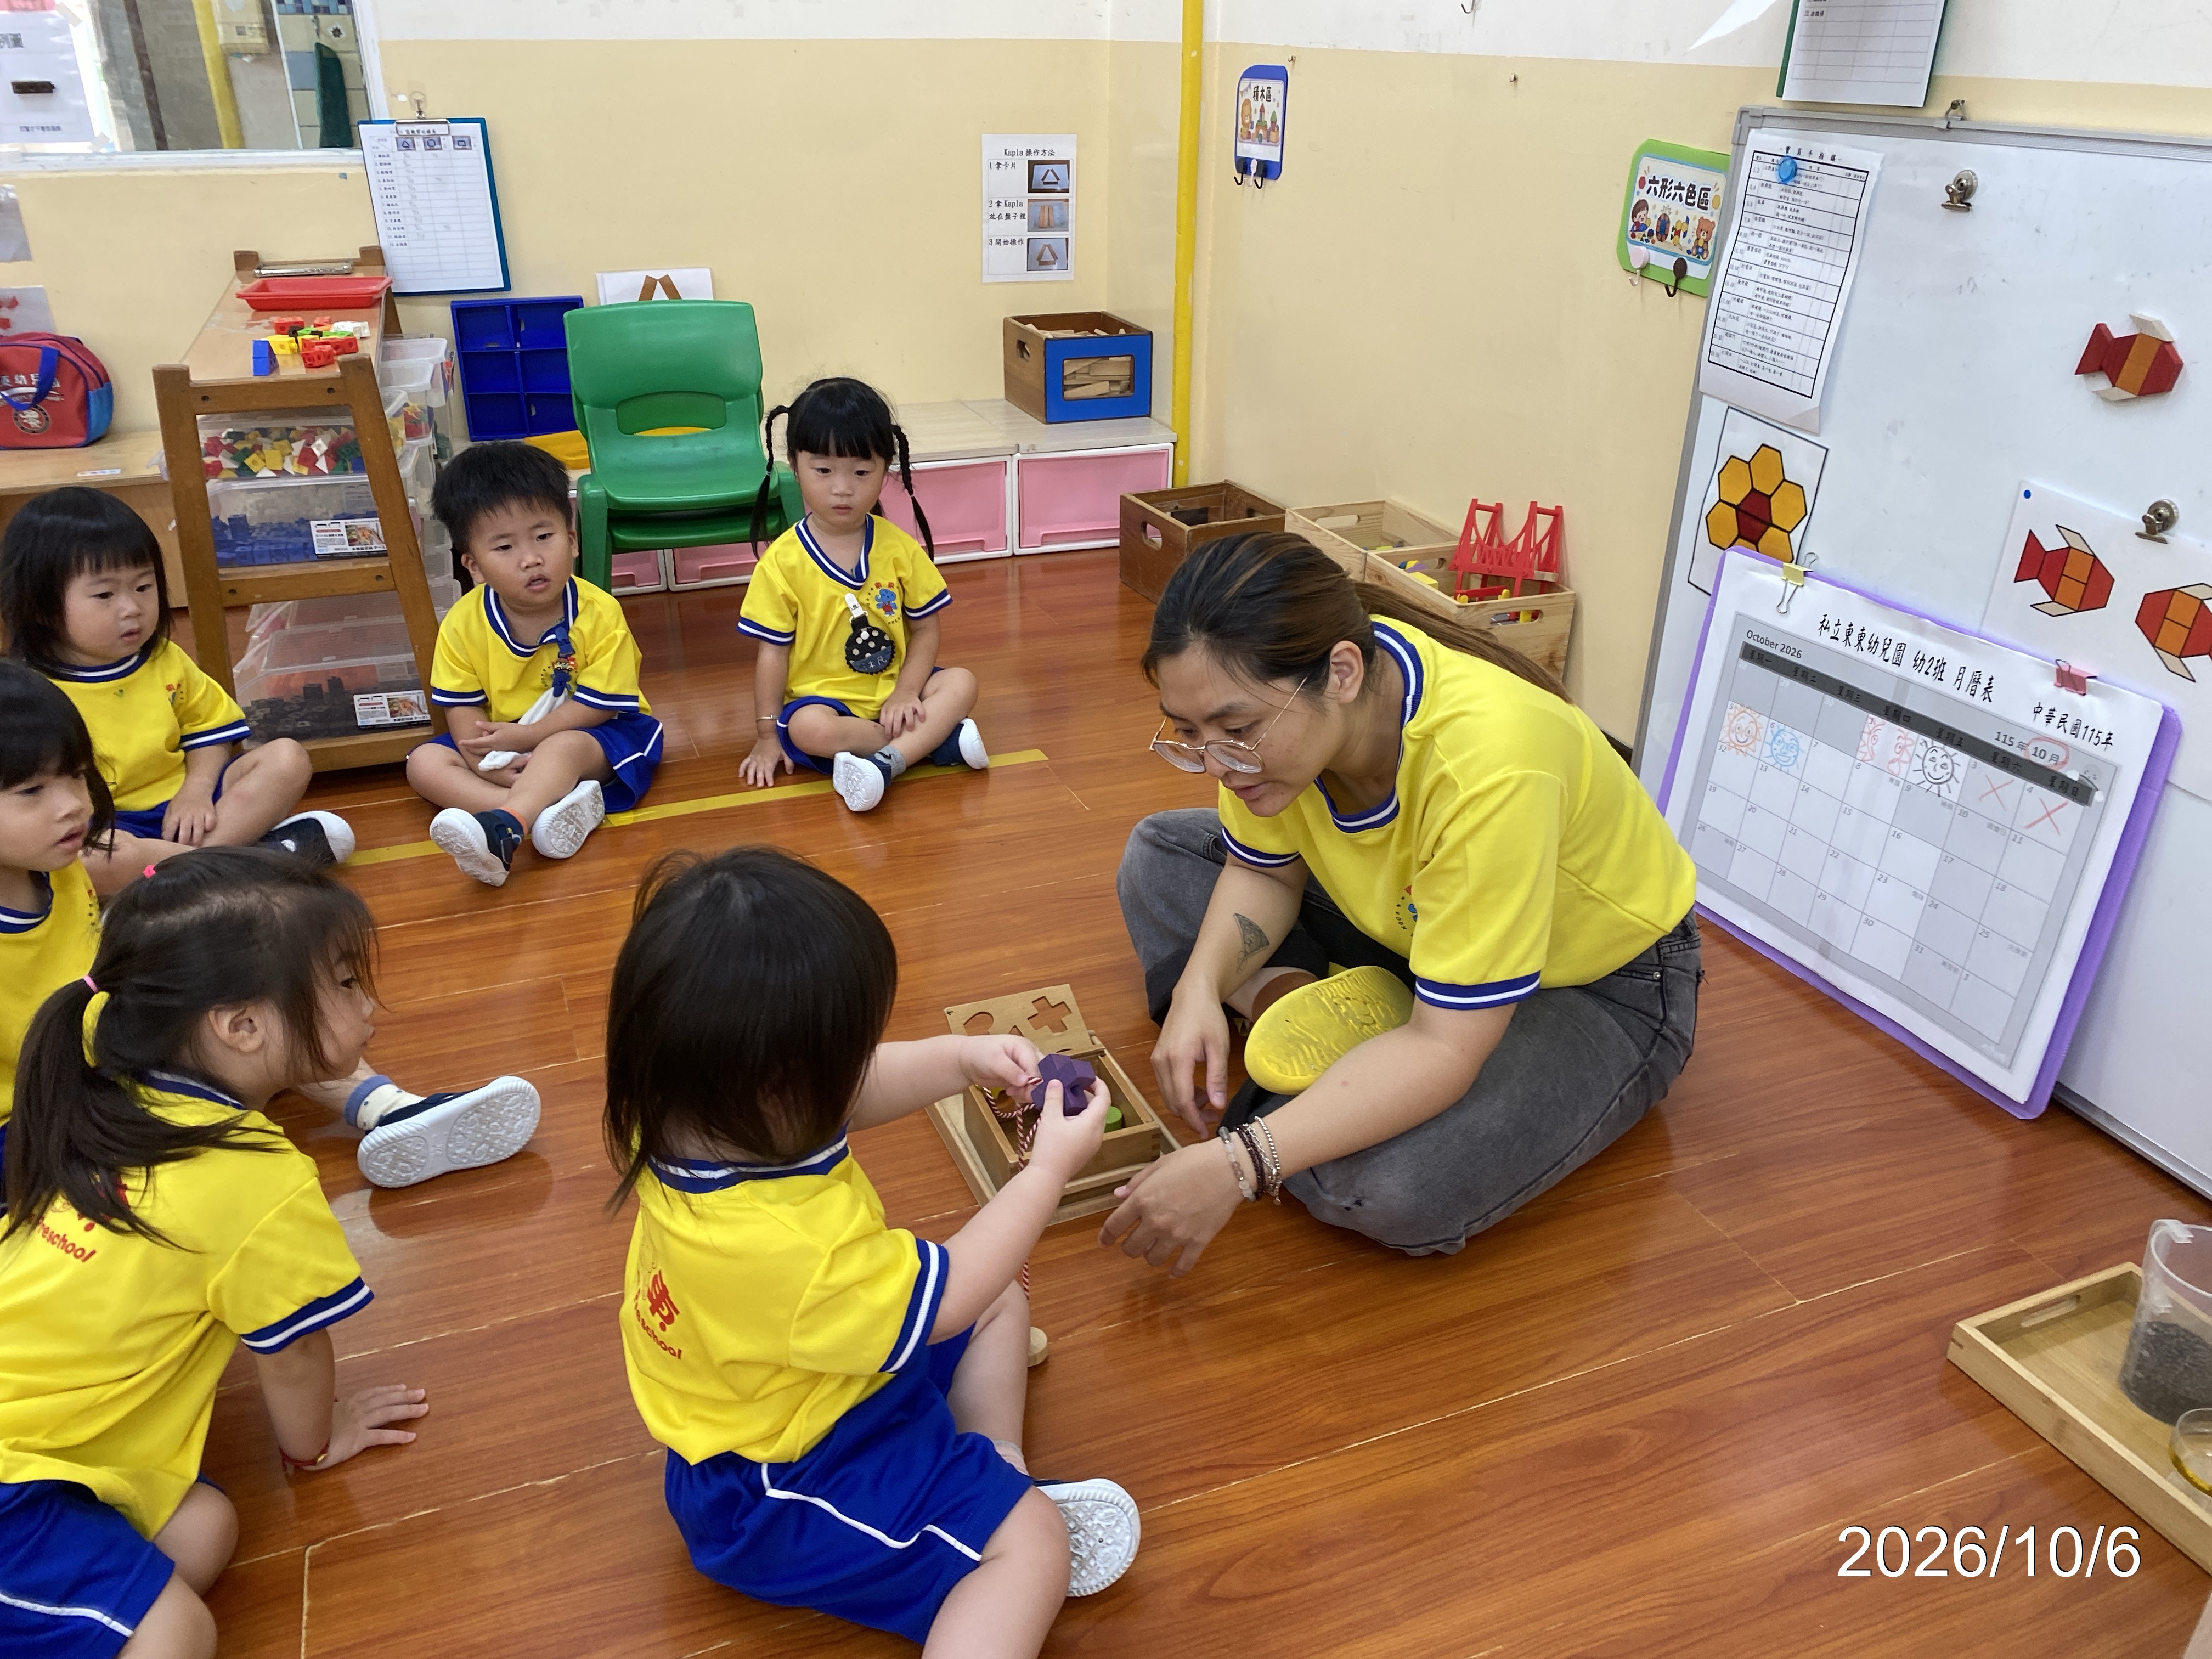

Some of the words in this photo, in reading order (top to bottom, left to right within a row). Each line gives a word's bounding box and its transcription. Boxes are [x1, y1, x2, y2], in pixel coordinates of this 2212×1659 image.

[1252, 86, 1272, 102] 積木區
[1004, 149, 1023, 157] Kapla
[995, 161, 1016, 170] 拿卡片
[1646, 175, 1711, 211] 六形六色區
[995, 200, 1002, 208] 拿
[1004, 200, 1023, 208] Kapla
[1746, 630, 1779, 650] October
[1780, 644, 1803, 659] 2026
[1750, 650, 1773, 664] 星期一
[1818, 614, 1906, 667] 私立東東幼兒園
[1912, 650, 1947, 681] 幼2班
[1953, 666, 1994, 702] 月曆表
[1792, 667, 1816, 683] 星期二
[1837, 686, 1861, 703] 星期三
[1824, 698, 1835, 707] 30
[1883, 705, 1911, 723] 星期四
[2033, 702, 2113, 752] 中華民國115年
[1936, 727, 1963, 747] 星期五
[1995, 731, 2015, 747] 115
[2016, 741, 2028, 752] 年
[2032, 747, 2046, 759] 10
[2049, 753, 2060, 765] 月
[1990, 751, 2023, 771] 星期六
[1759, 764, 1768, 772] 13
[1801, 785, 1810, 793] 14
[2049, 775, 2079, 797] 星期日
[1748, 805, 1757, 813] 20
[1842, 807, 1852, 815] 15
[1957, 809, 1968, 818] 10
[1788, 827, 1797, 836] 21
[1891, 830, 1902, 839] 16
[2012, 835, 2023, 844] 11
[1737, 845, 1746, 853] 27
[1830, 850, 1839, 859] 22
[1943, 855, 1954, 864] 17
[1777, 868, 1787, 877] 28
[1877, 874, 1888, 883] 23
[1995, 882, 2007, 891] 18
[1817, 892, 1827, 901] 29
[1928, 900, 1938, 909] 24
[1863, 917, 1874, 926] 30
[1978, 928, 1990, 938] 25
[1914, 944, 1923, 954] 31
